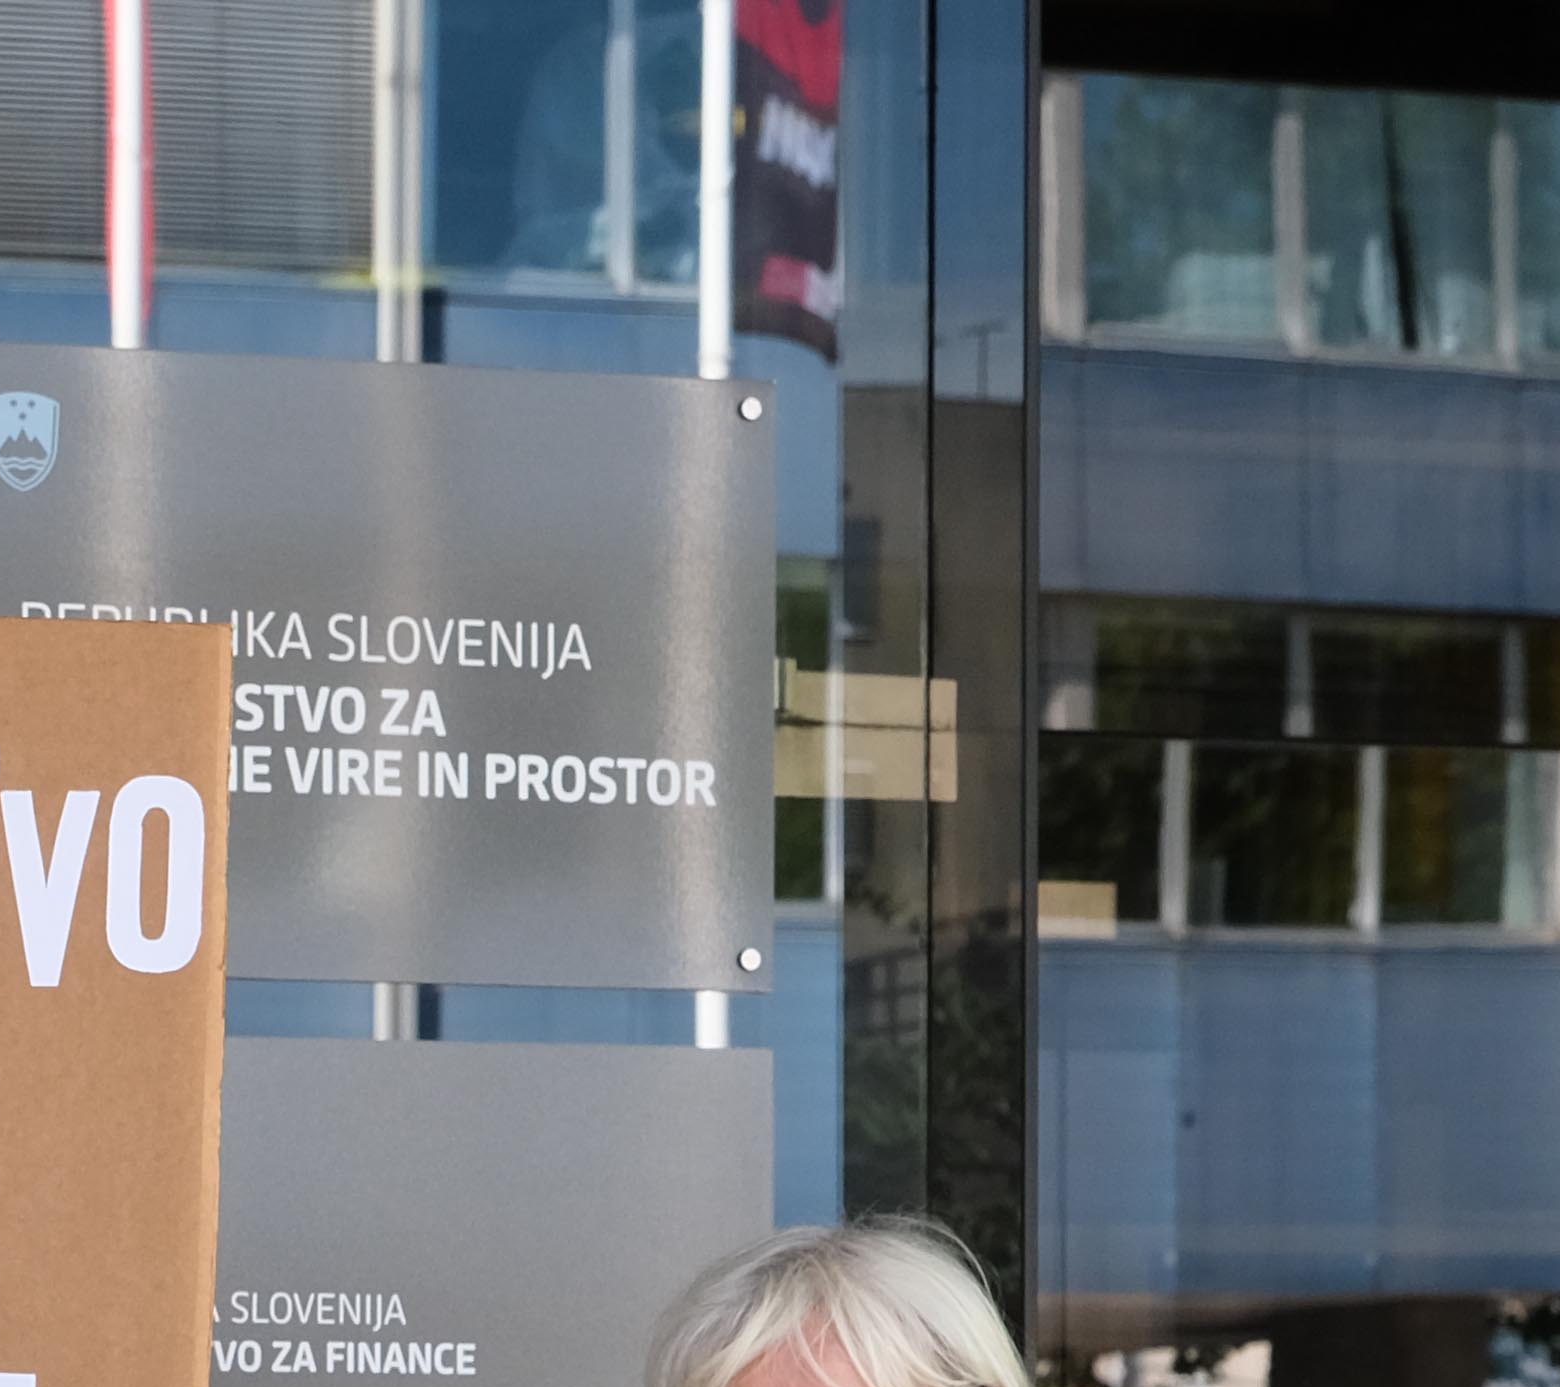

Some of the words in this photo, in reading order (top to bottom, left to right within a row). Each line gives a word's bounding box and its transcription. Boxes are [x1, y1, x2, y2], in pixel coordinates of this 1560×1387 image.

[328, 614, 592, 680] SLOVENIJA
[381, 688, 445, 736] ZA
[285, 748, 401, 798] VIRE
[419, 753, 468, 800] IN
[486, 756, 716, 808] PROSTOR
[231, 1291, 407, 1332] SLOVENIJA
[212, 1340, 262, 1373] VO
[271, 1341, 317, 1373] ZA
[326, 1342, 476, 1375] FINANCE
